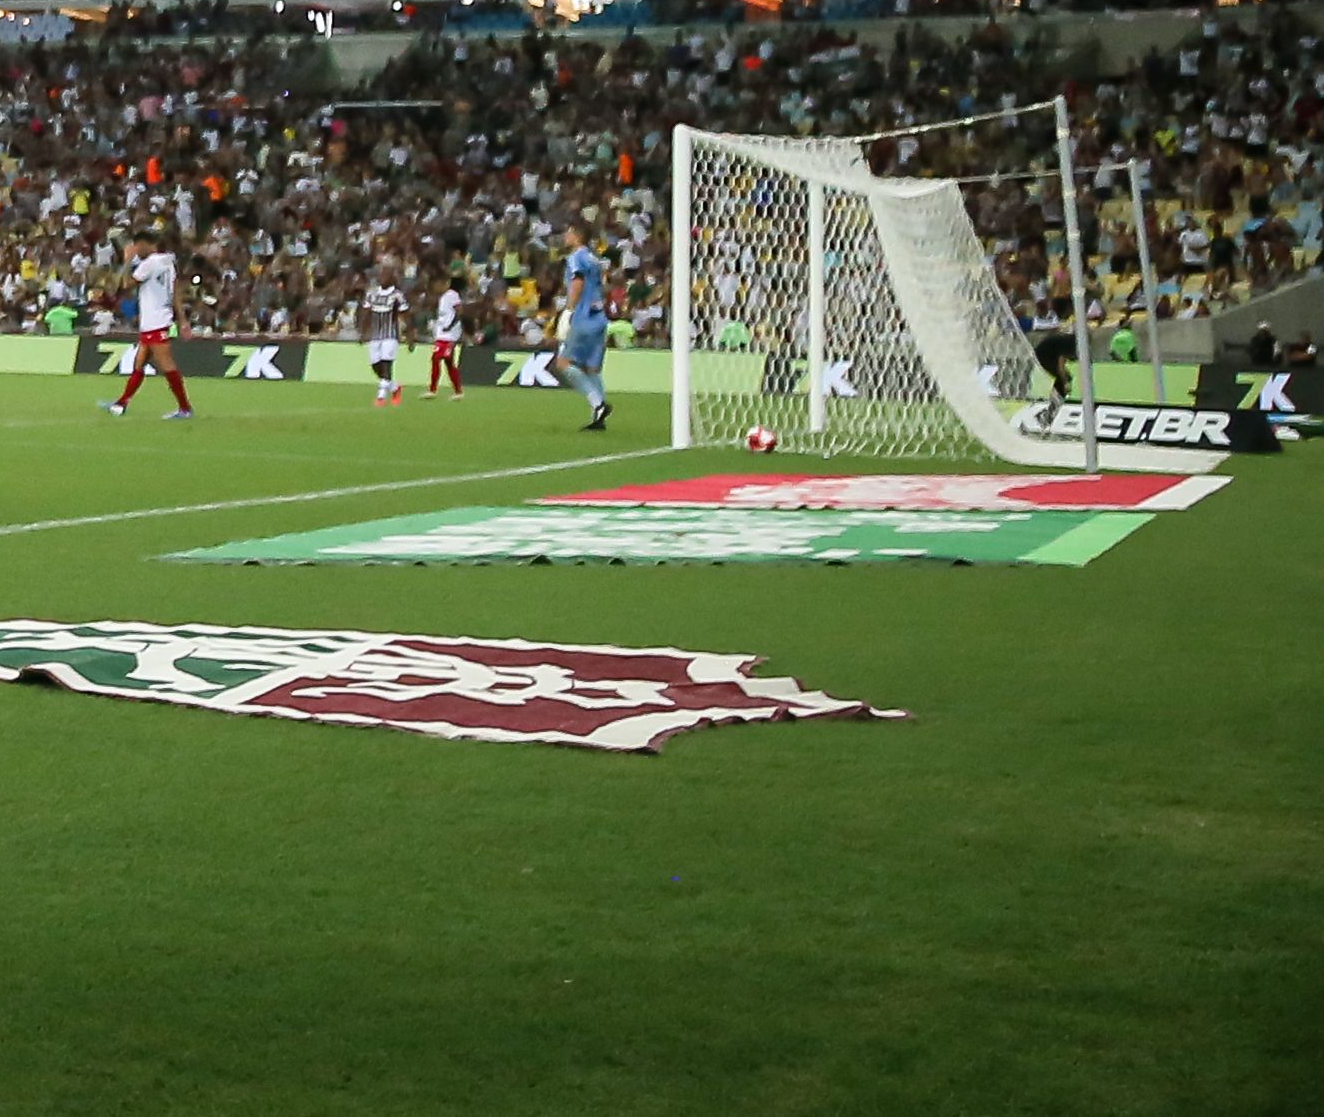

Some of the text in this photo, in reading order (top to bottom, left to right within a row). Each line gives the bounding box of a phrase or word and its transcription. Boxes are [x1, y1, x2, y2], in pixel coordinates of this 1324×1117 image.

[222, 345, 284, 379] 7K
[494, 351, 560, 387] 7K
[1236, 372, 1296, 412] 7K
